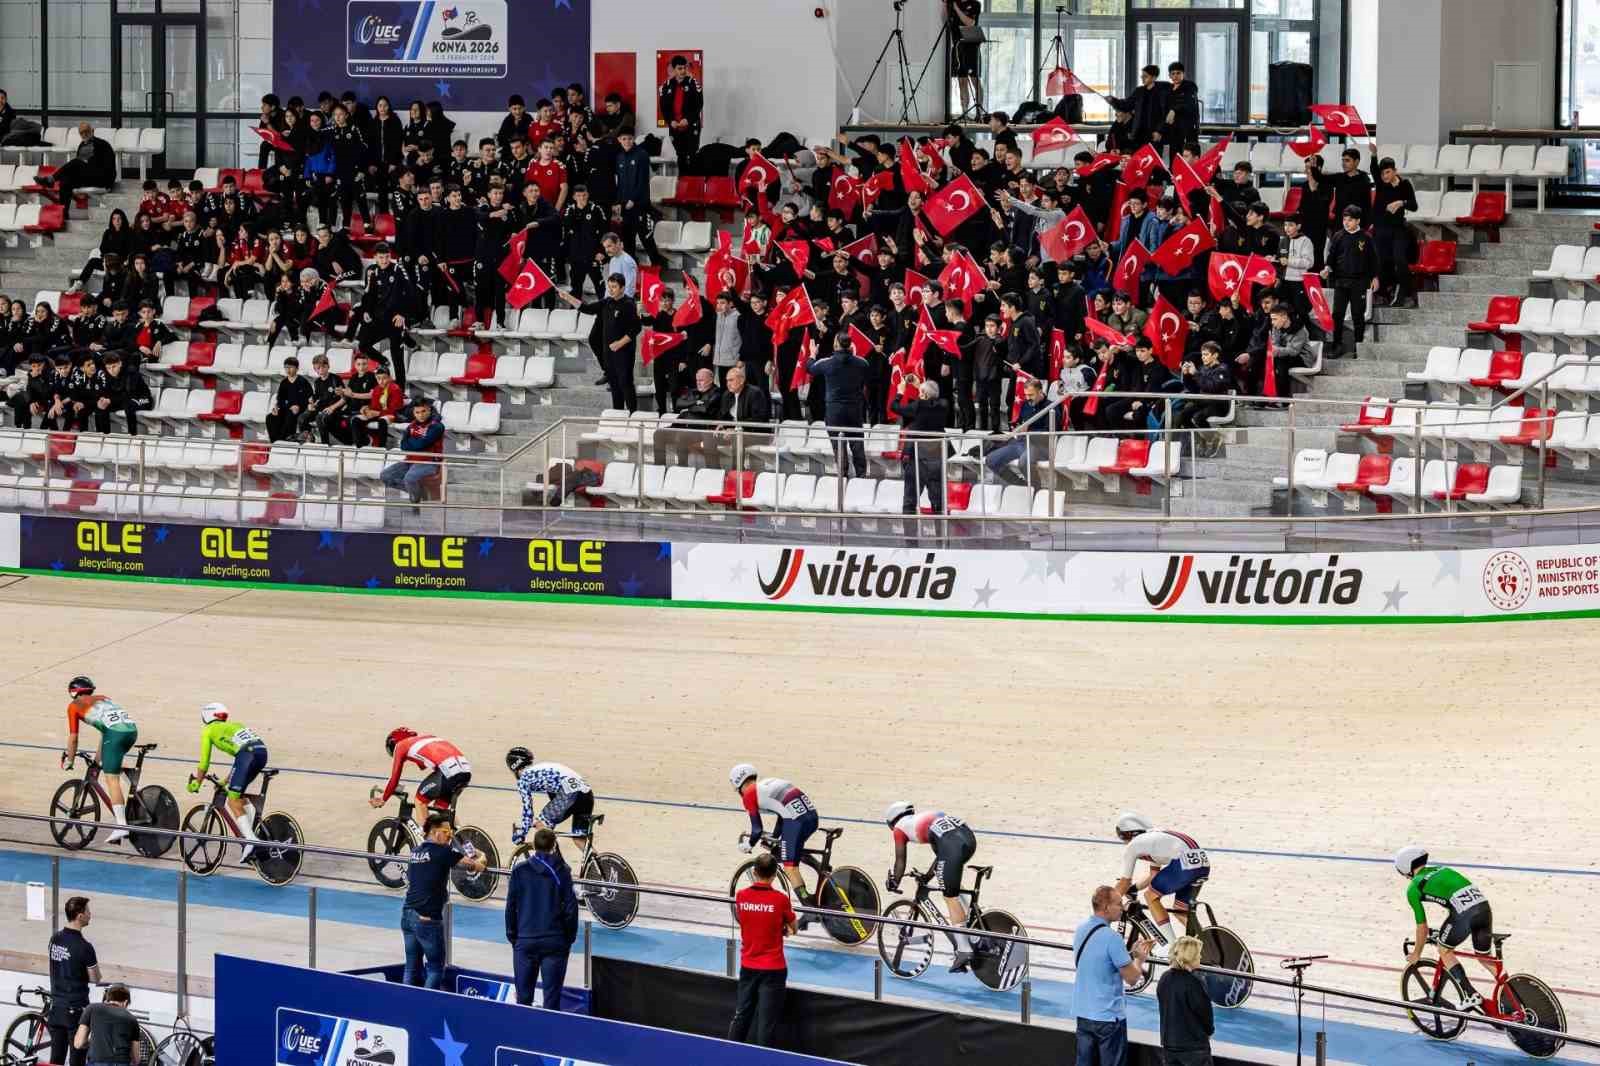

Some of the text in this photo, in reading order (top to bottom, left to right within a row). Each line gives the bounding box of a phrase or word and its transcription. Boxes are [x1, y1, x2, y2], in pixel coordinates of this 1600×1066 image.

[374, 25, 402, 38] UEC
[432, 41, 500, 53] KONYA 2026
[79, 556, 144, 572] alecycling.com
[1536, 556, 1597, 570] REPUBLIC OF
[203, 563, 271, 579] alecycling.com
[807, 550, 957, 600] vittoria
[1537, 570, 1598, 583] MINISTRY OF
[395, 573, 466, 588] alecycling.com
[530, 577, 605, 593] alecycling.com
[1197, 555, 1363, 605] vittoria
[1539, 584, 1600, 598] AND SPORTS
[1186, 851, 1201, 865] 59
[1456, 889, 1473, 906] 72
[299, 1035, 321, 1049] UEC
